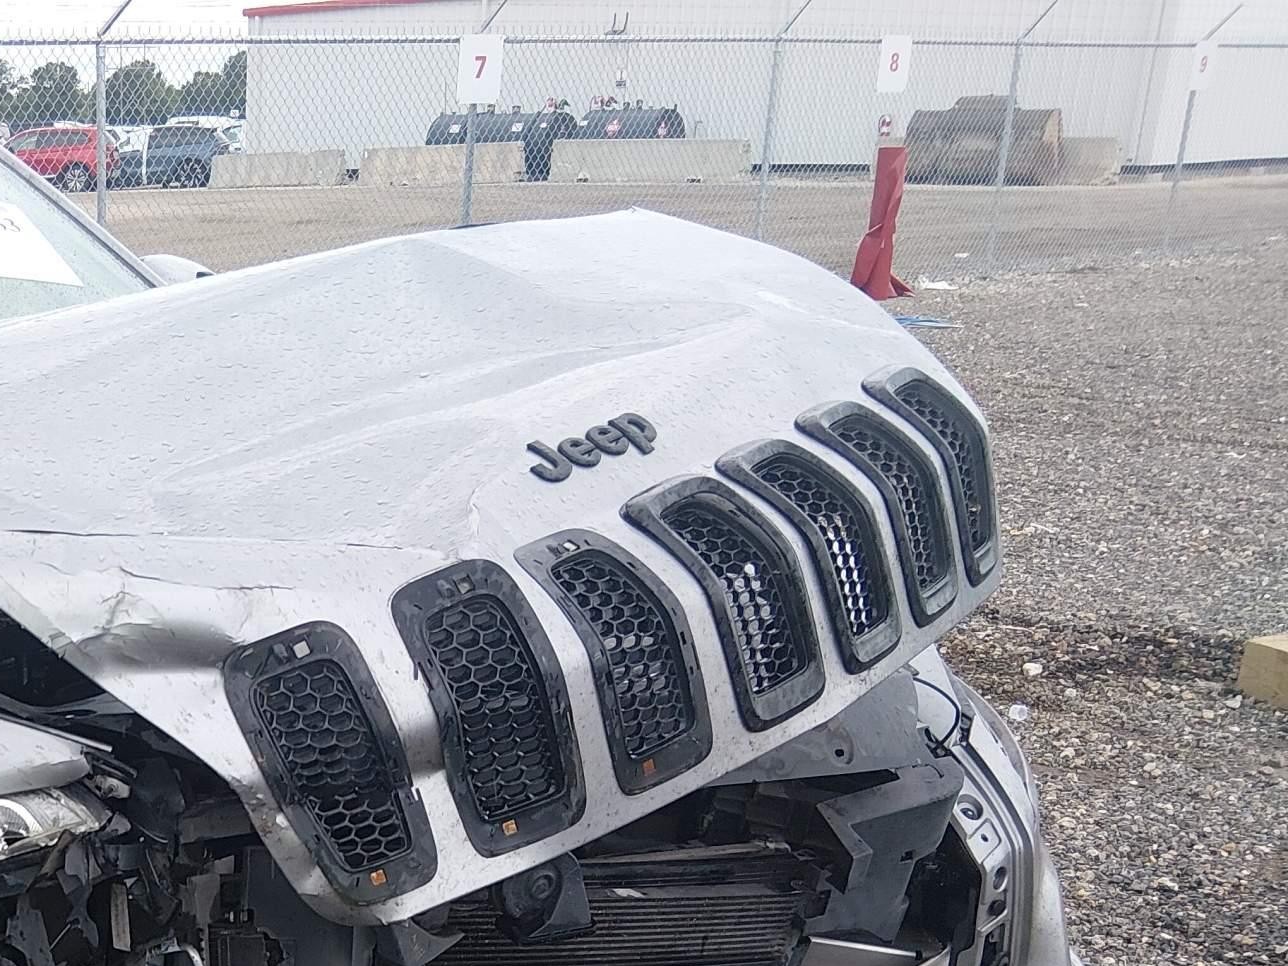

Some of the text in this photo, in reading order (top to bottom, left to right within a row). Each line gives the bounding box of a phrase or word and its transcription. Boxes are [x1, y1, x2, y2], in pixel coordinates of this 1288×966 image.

[475, 55, 487, 79] 7
[890, 52, 899, 72] 8
[1200, 55, 1208, 72] 9
[526, 412, 657, 483] Jeep
